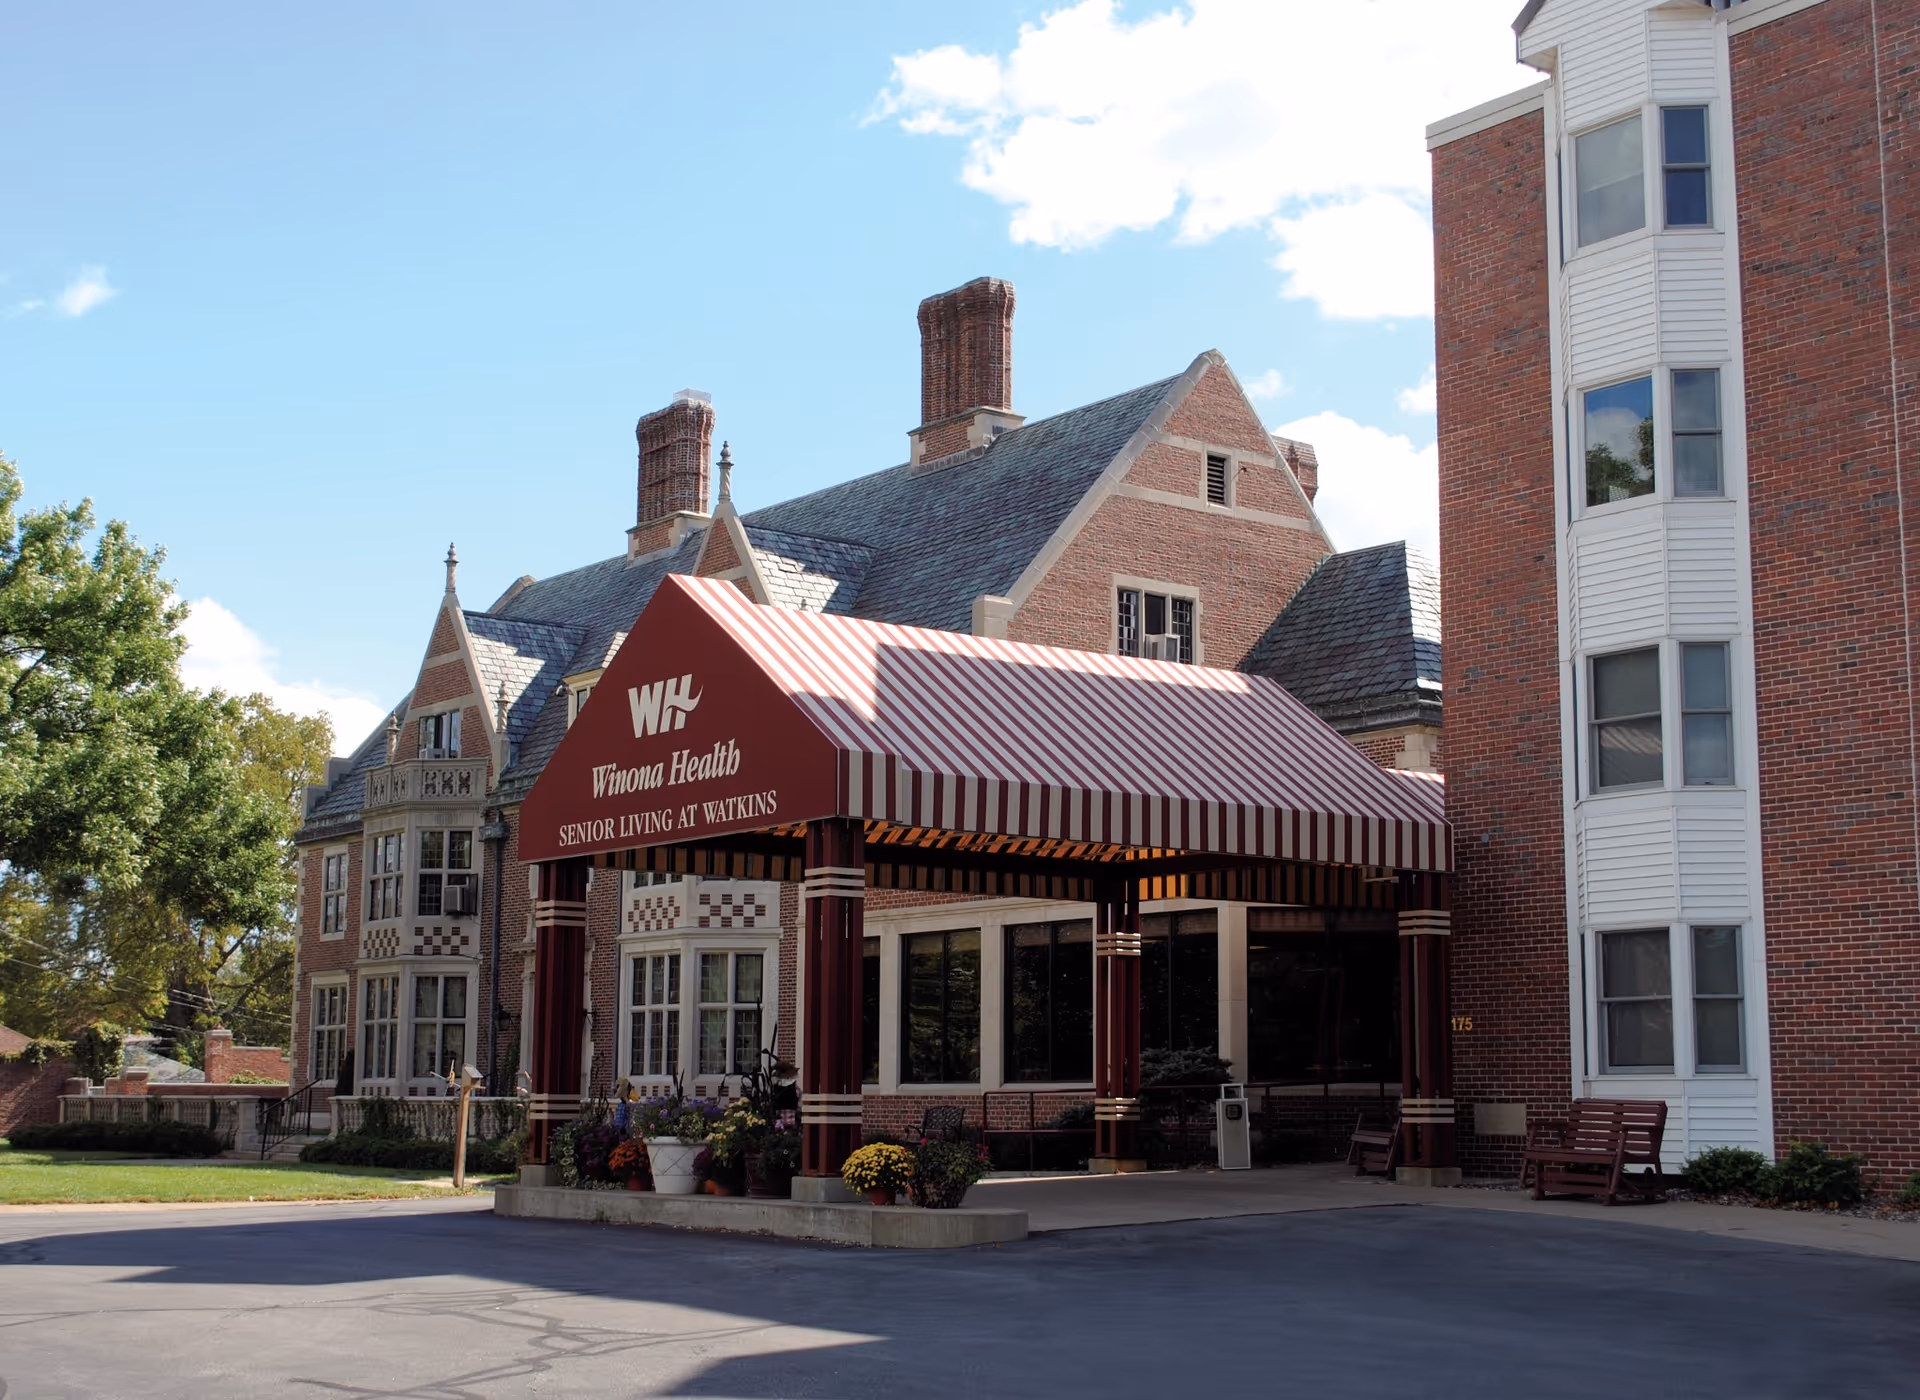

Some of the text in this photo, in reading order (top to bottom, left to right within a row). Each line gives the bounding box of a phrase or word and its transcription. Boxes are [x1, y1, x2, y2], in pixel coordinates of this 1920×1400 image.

[592, 738, 741, 799] Winona Health
[558, 790, 777, 846] SENIOR LIVING AT WATKINS
